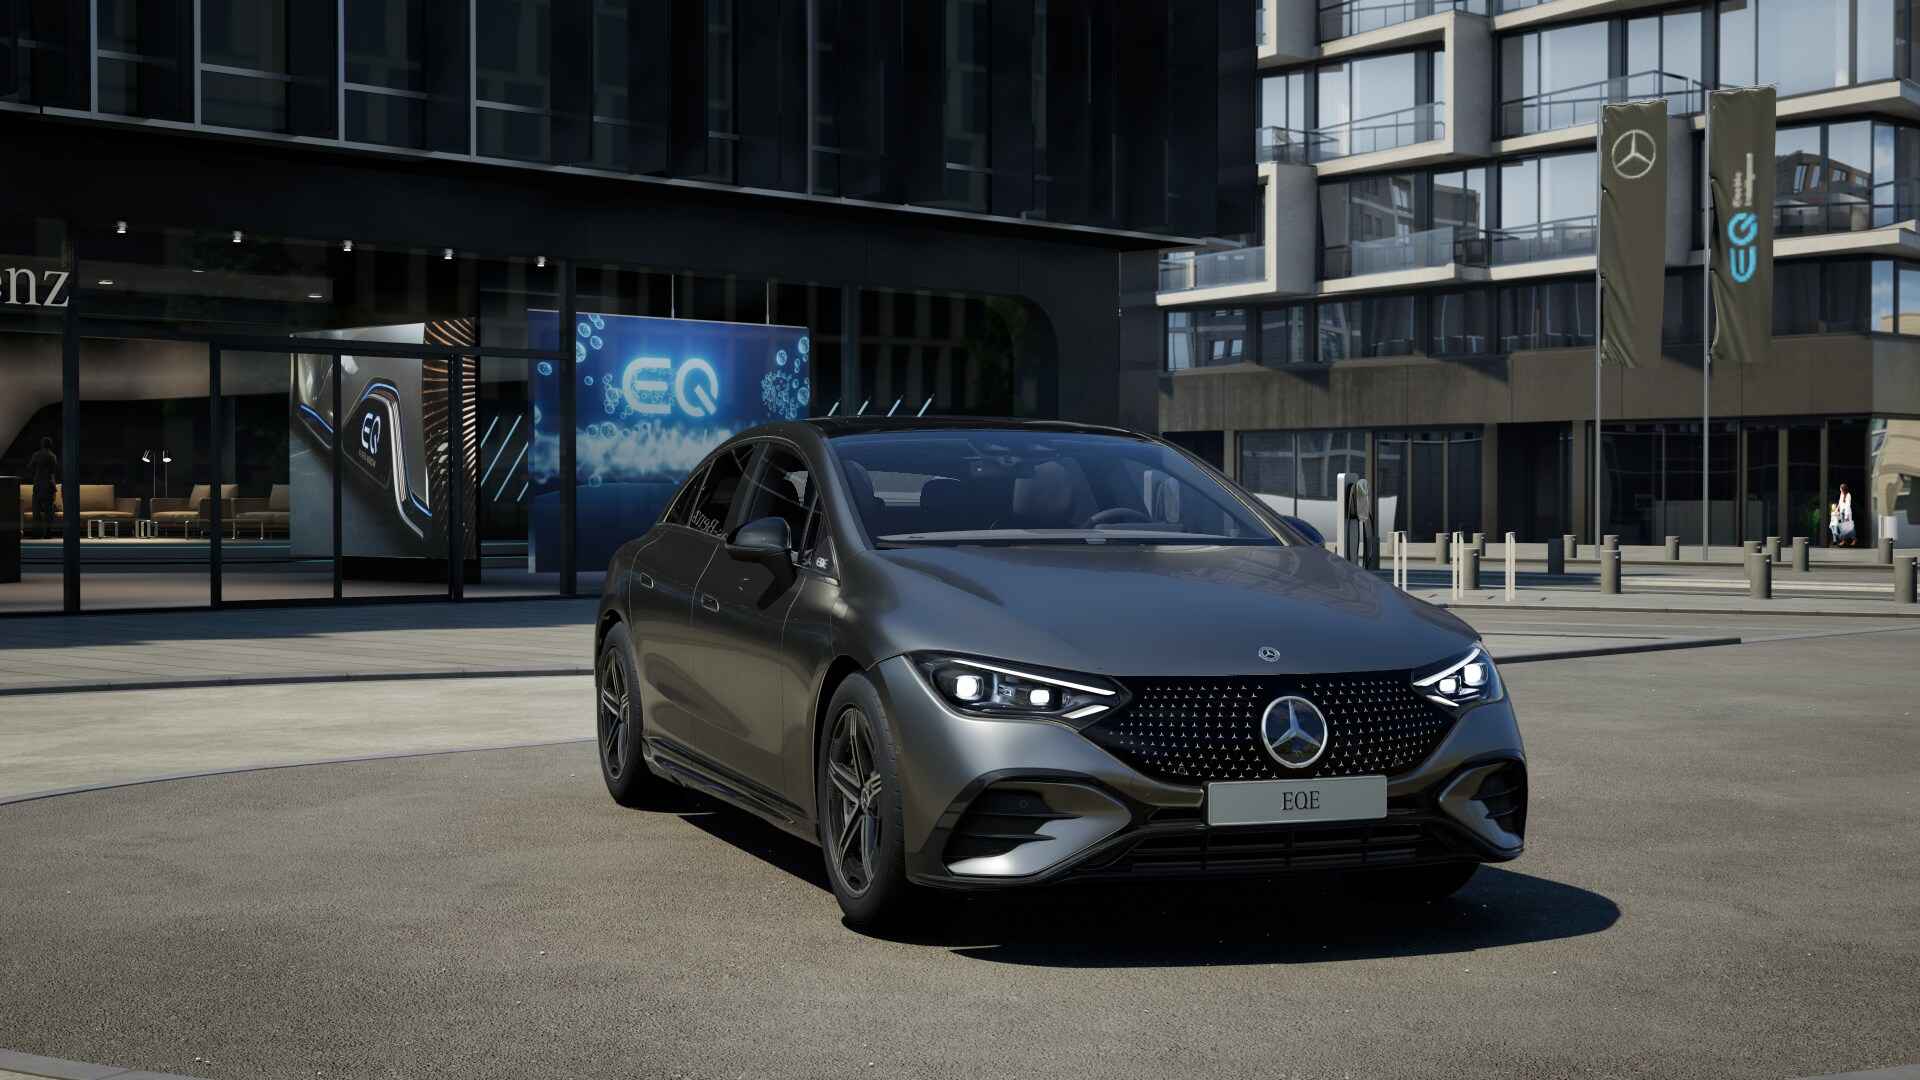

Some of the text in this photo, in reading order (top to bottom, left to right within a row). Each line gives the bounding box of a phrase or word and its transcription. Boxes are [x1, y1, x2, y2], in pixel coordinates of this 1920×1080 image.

[1728, 212, 1758, 283] EQ
[0, 267, 70, 307] nz
[622, 357, 719, 417] EQ
[361, 411, 381, 455] EQ
[1281, 790, 1321, 811] EQE
